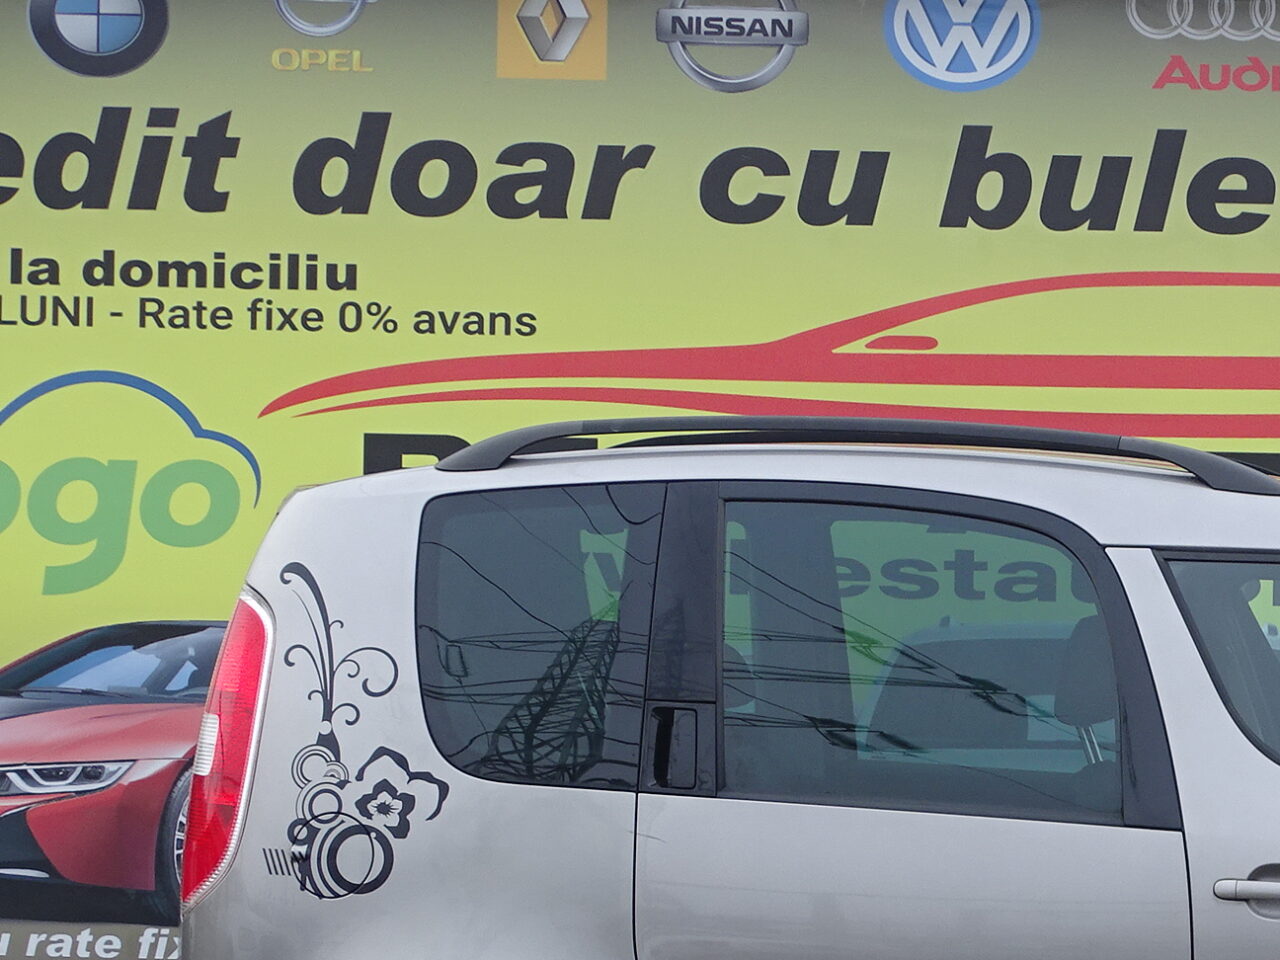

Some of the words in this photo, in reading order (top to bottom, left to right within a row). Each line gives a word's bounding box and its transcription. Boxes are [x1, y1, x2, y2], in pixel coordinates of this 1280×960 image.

[671, 16, 793, 38] NISSAN
[271, 48, 374, 72] OPEL
[0, 106, 241, 213] dit
[293, 111, 656, 219] doar
[699, 146, 891, 226] cu
[10, 247, 60, 285] la
[82, 250, 358, 291] domiciliu
[139, 297, 233, 330] Rate
[247, 298, 325, 332] fixe
[339, 301, 399, 334] 0%
[413, 309, 538, 337] avans
[0, 457, 241, 596] go
[25, 927, 122, 959] rate
